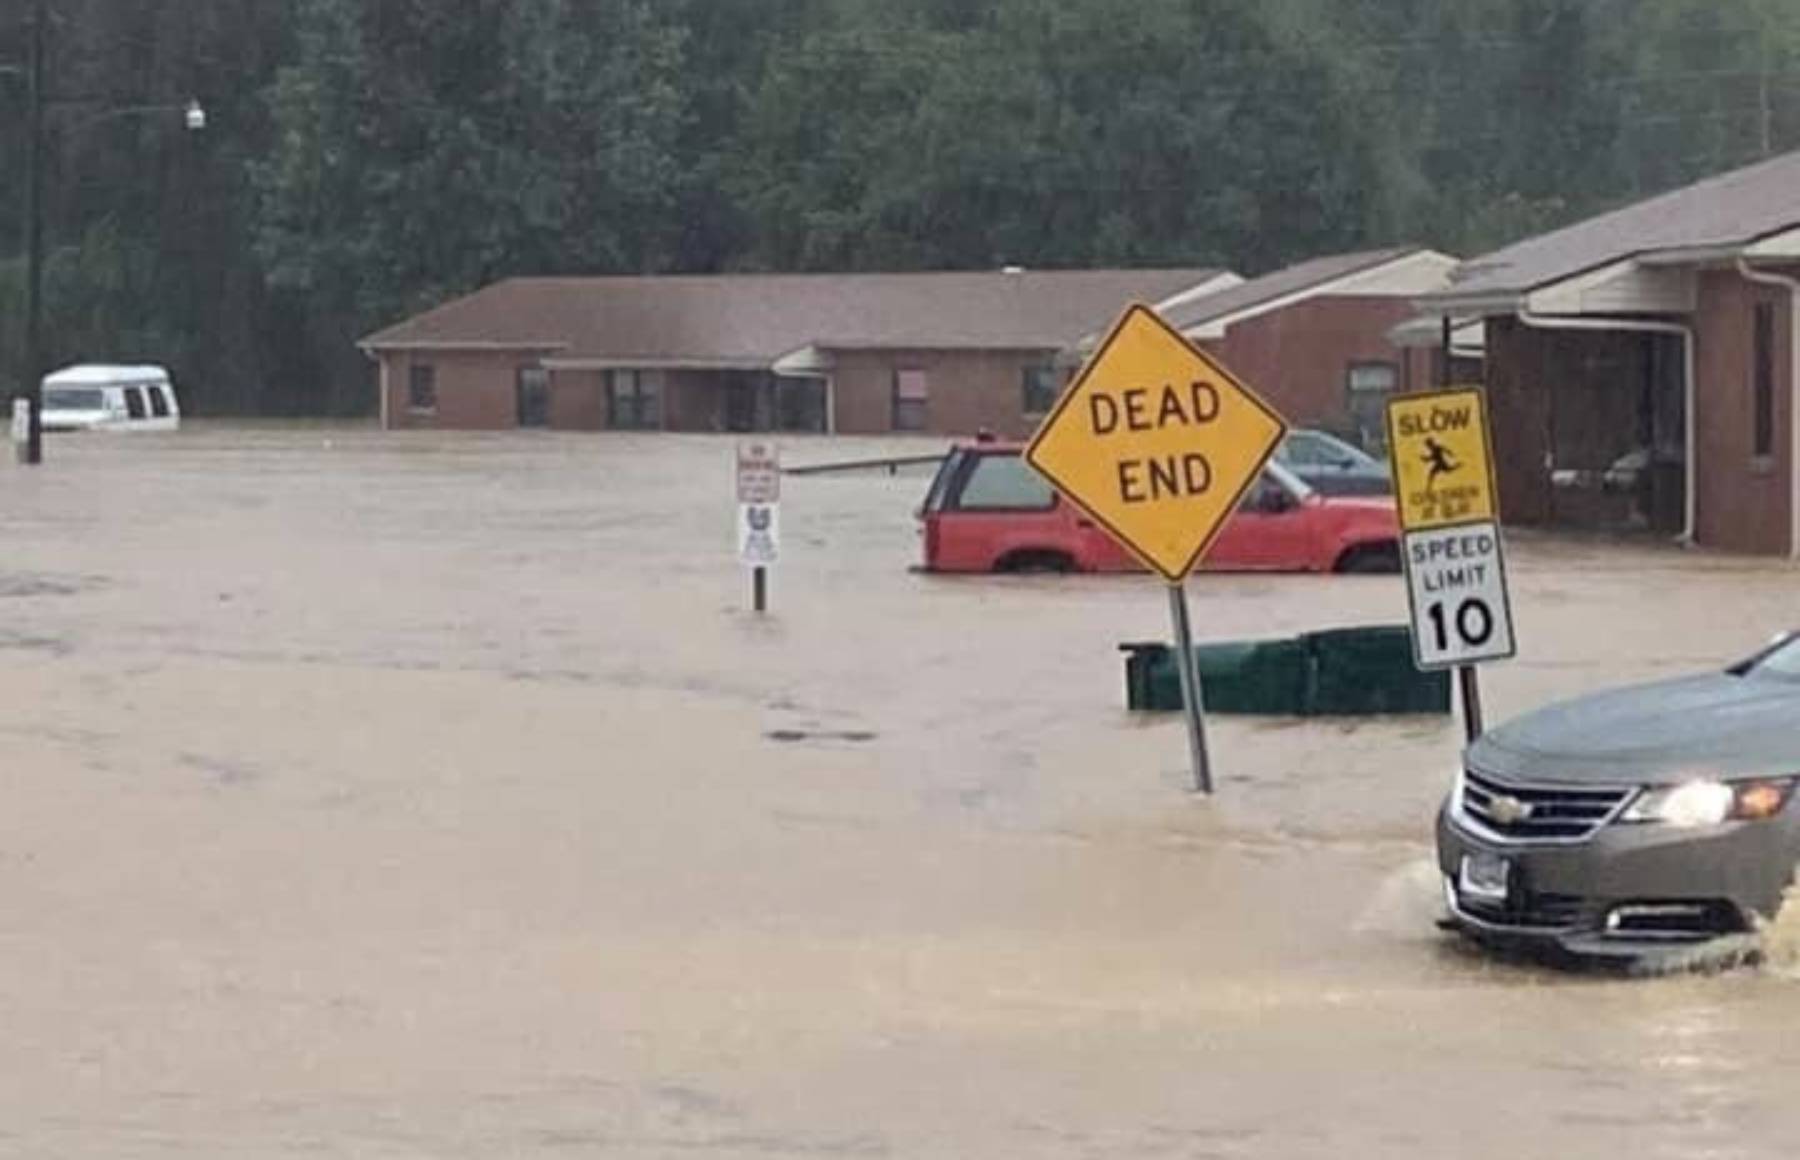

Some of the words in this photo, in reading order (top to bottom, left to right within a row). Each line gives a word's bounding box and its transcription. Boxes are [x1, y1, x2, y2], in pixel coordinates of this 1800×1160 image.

[1090, 381, 1220, 435] DEAD
[1399, 405, 1470, 437] SLOW
[1118, 452, 1212, 503] END
[1412, 534, 1493, 564] SPEED
[1423, 564, 1485, 591] LIMIT
[1428, 597, 1493, 651] 10
